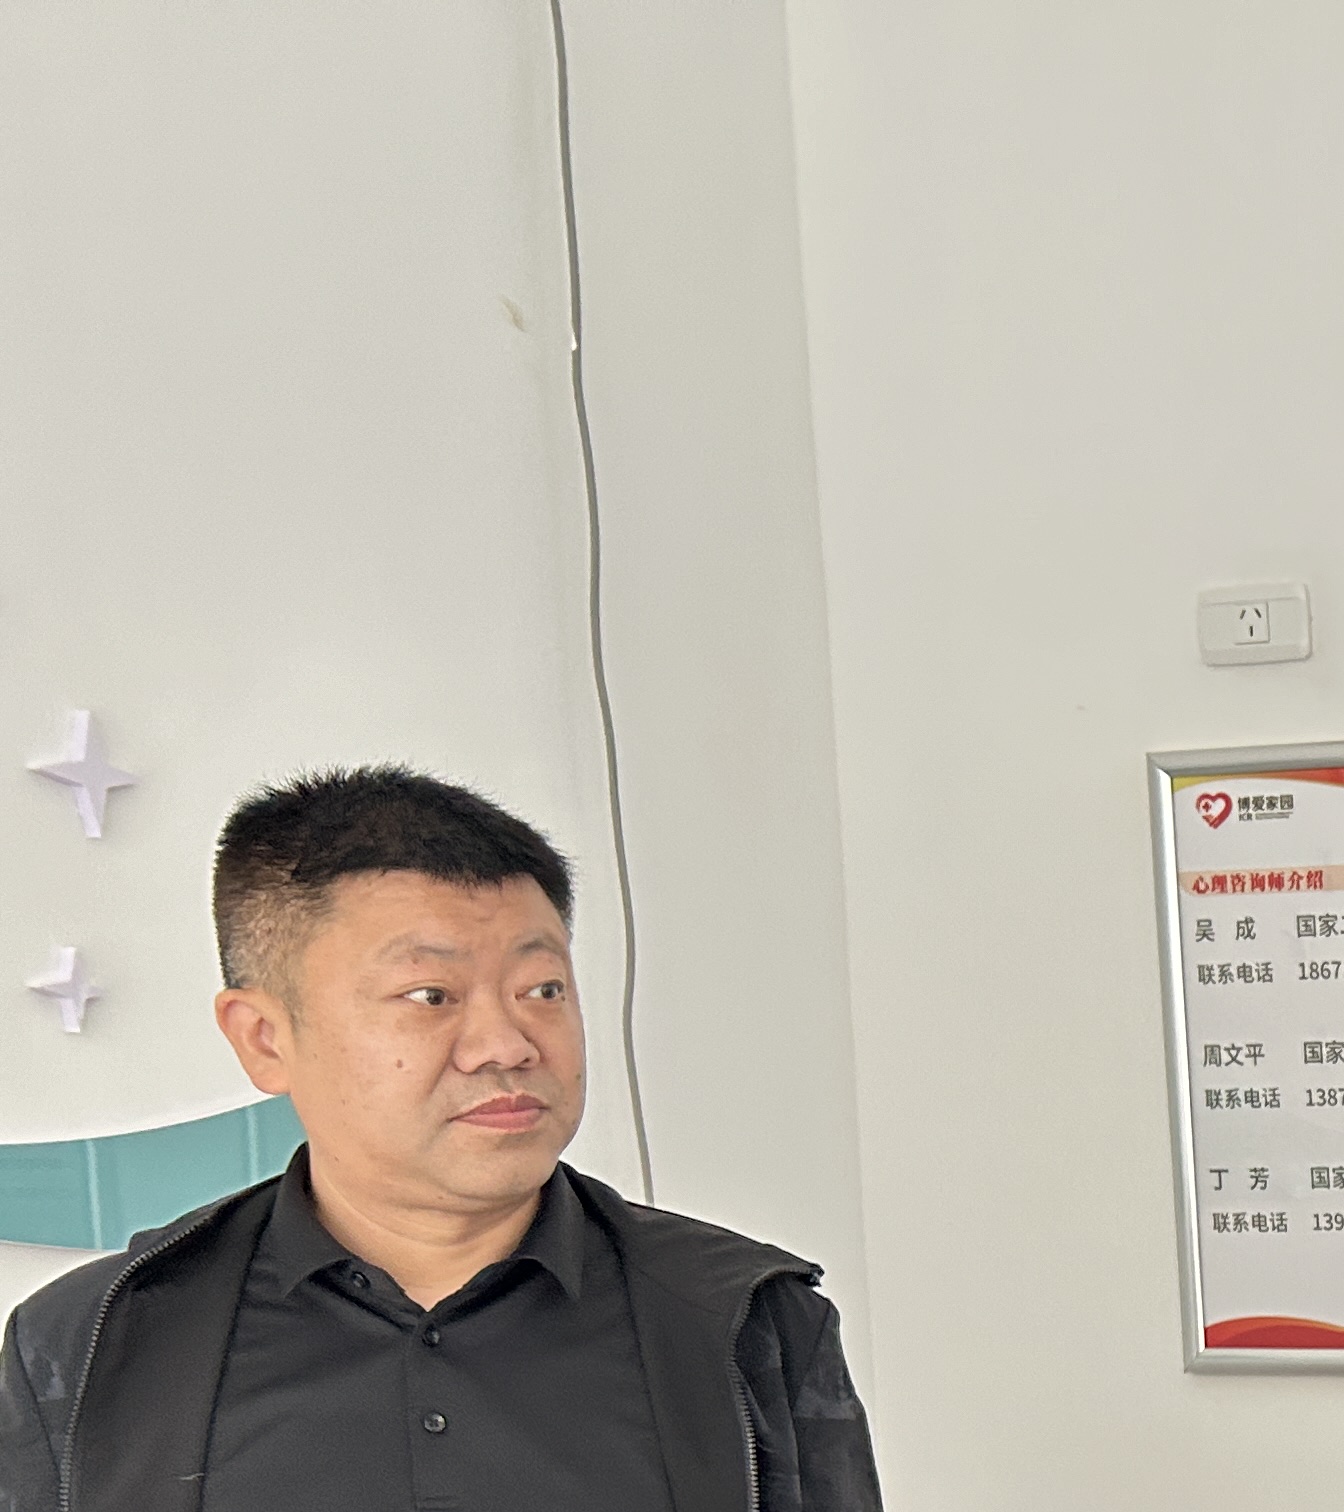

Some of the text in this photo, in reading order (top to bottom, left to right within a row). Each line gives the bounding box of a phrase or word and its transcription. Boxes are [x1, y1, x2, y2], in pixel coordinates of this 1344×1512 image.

[1192, 869, 1325, 894] 心理咨询师介绍
[1197, 961, 1274, 985] 联系电话
[1203, 1042, 1266, 1067] 周文平
[1205, 1086, 1282, 1109] 联系电话
[1212, 1211, 1289, 1234] 联系电话
